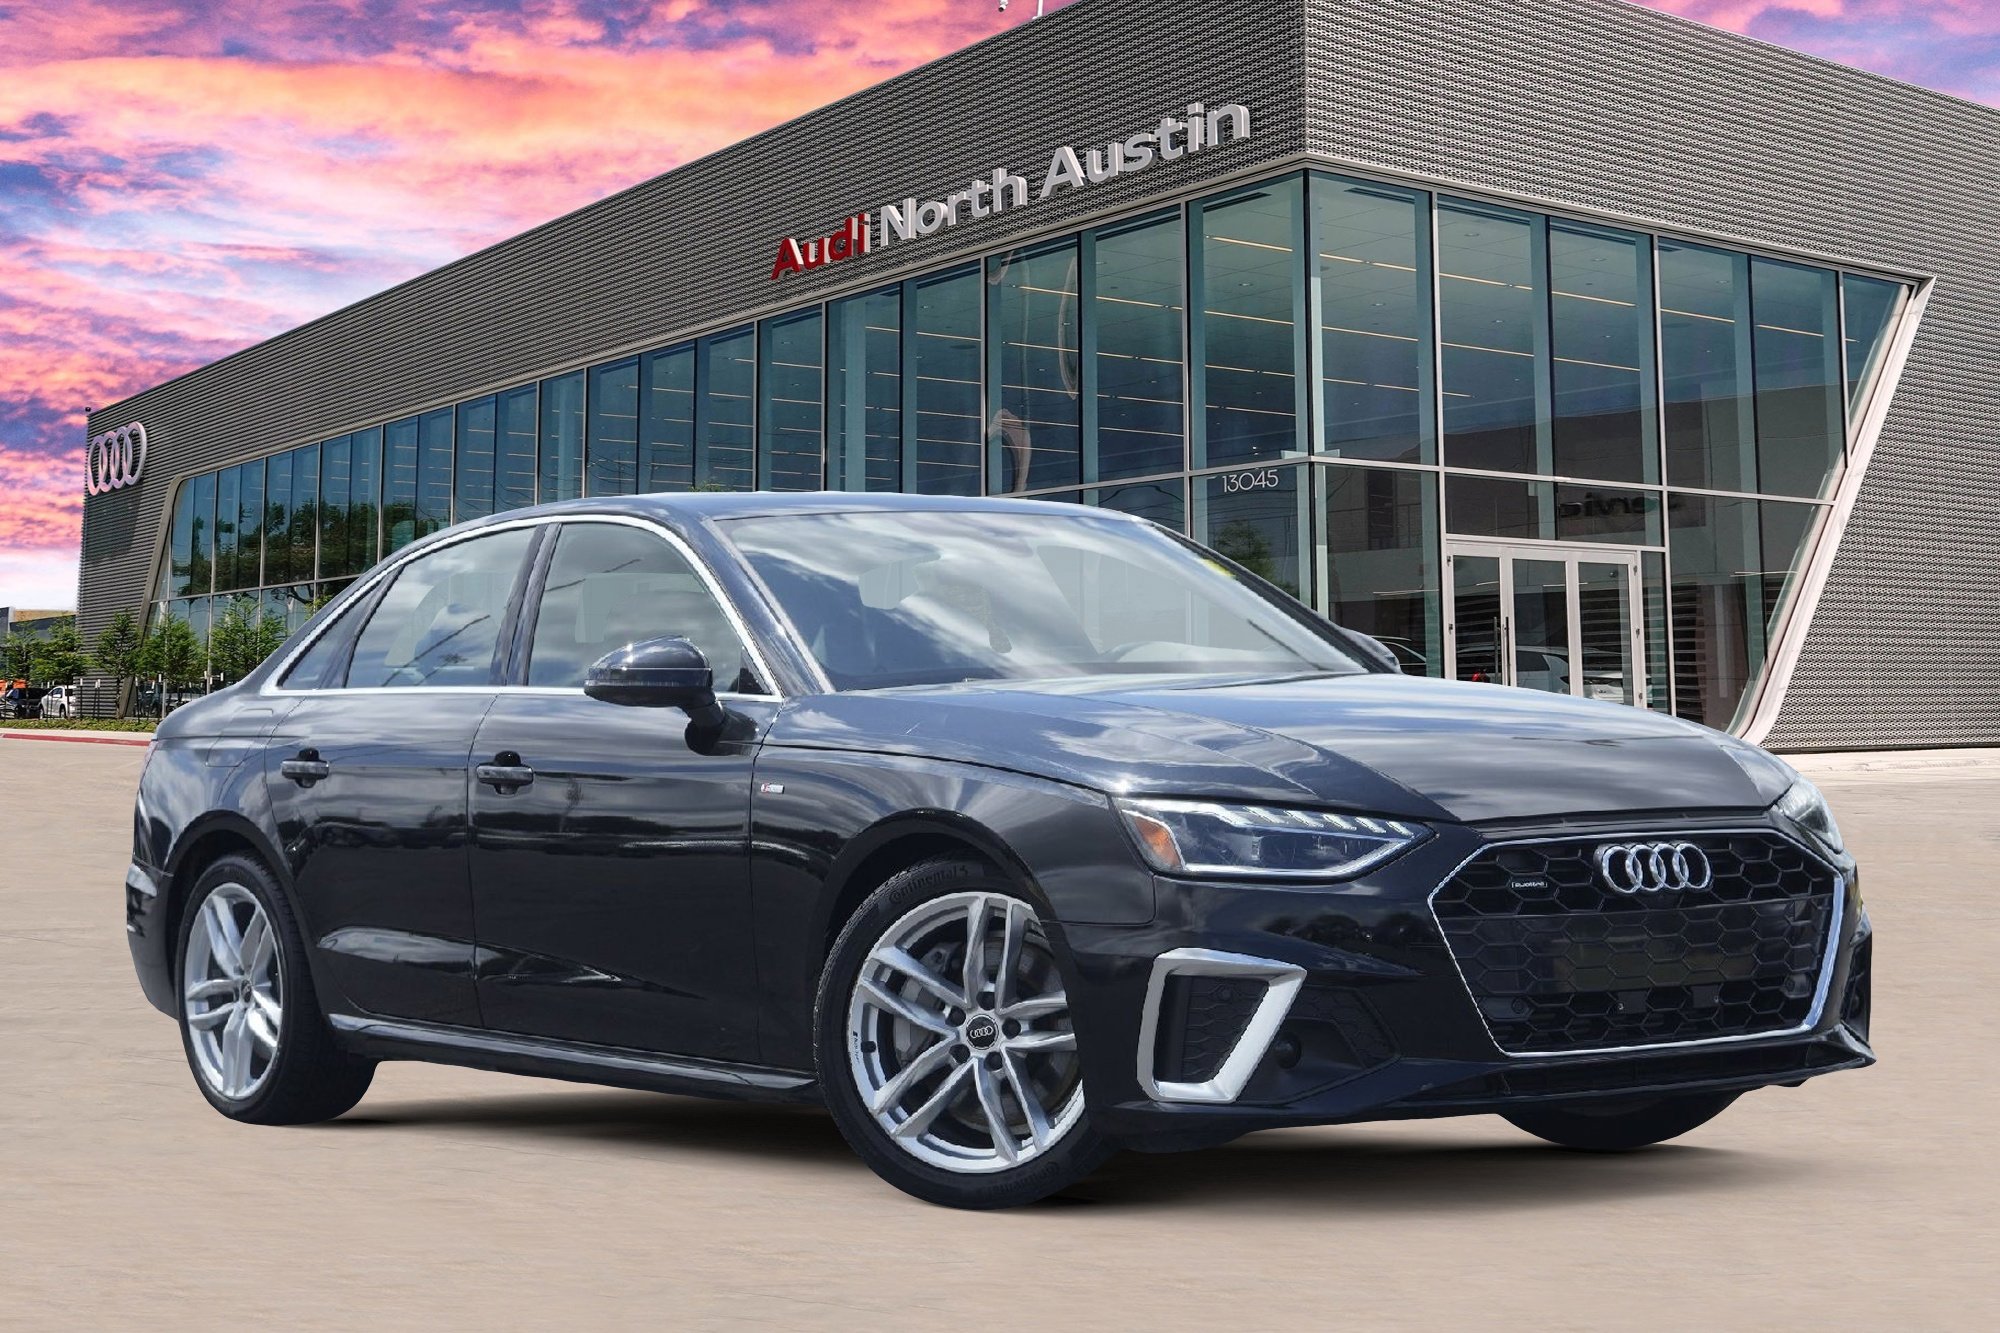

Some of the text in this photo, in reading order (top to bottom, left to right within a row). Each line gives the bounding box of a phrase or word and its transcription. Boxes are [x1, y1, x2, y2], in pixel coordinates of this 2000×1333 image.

[770, 102, 1251, 280] Audi North Austin
[1222, 469, 1279, 493] 13045
